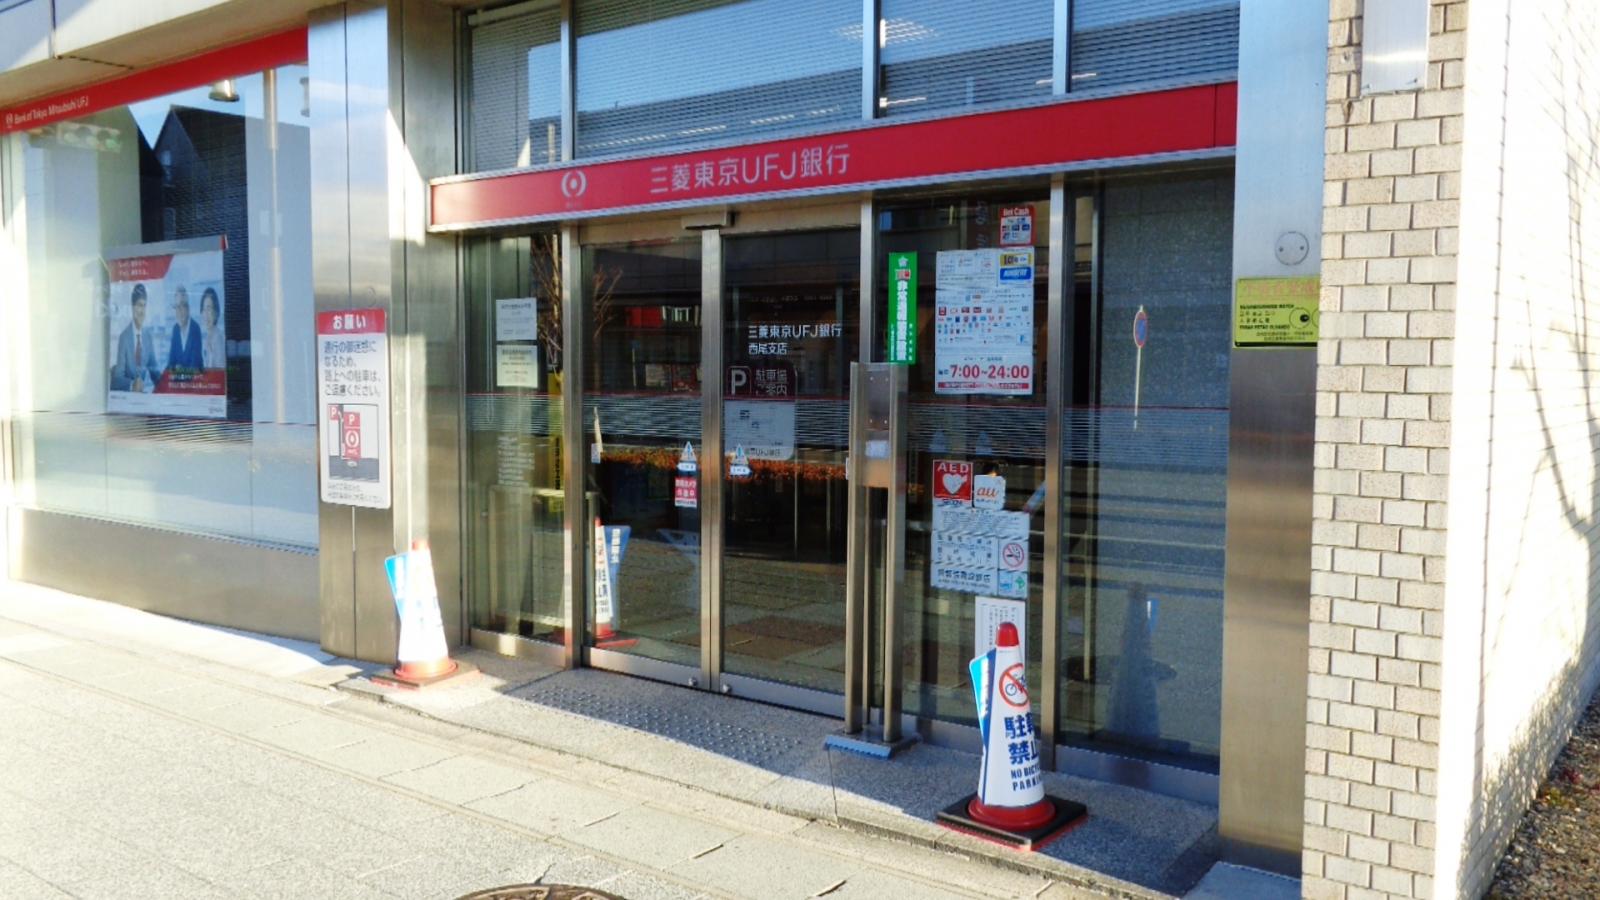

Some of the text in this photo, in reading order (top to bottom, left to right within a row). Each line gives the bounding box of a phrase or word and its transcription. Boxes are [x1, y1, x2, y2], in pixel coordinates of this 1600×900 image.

[650, 143, 850, 193] 三菱東京UFJ銀行
[333, 313, 366, 330] お願い
[748, 323, 842, 339] 三菱東京UFJ銀行
[748, 342, 788, 355] 西尾支店
[731, 369, 747, 395] P
[937, 462, 969, 473] AED
[977, 487, 999, 497] au
[1011, 768, 1023, 779] NO
